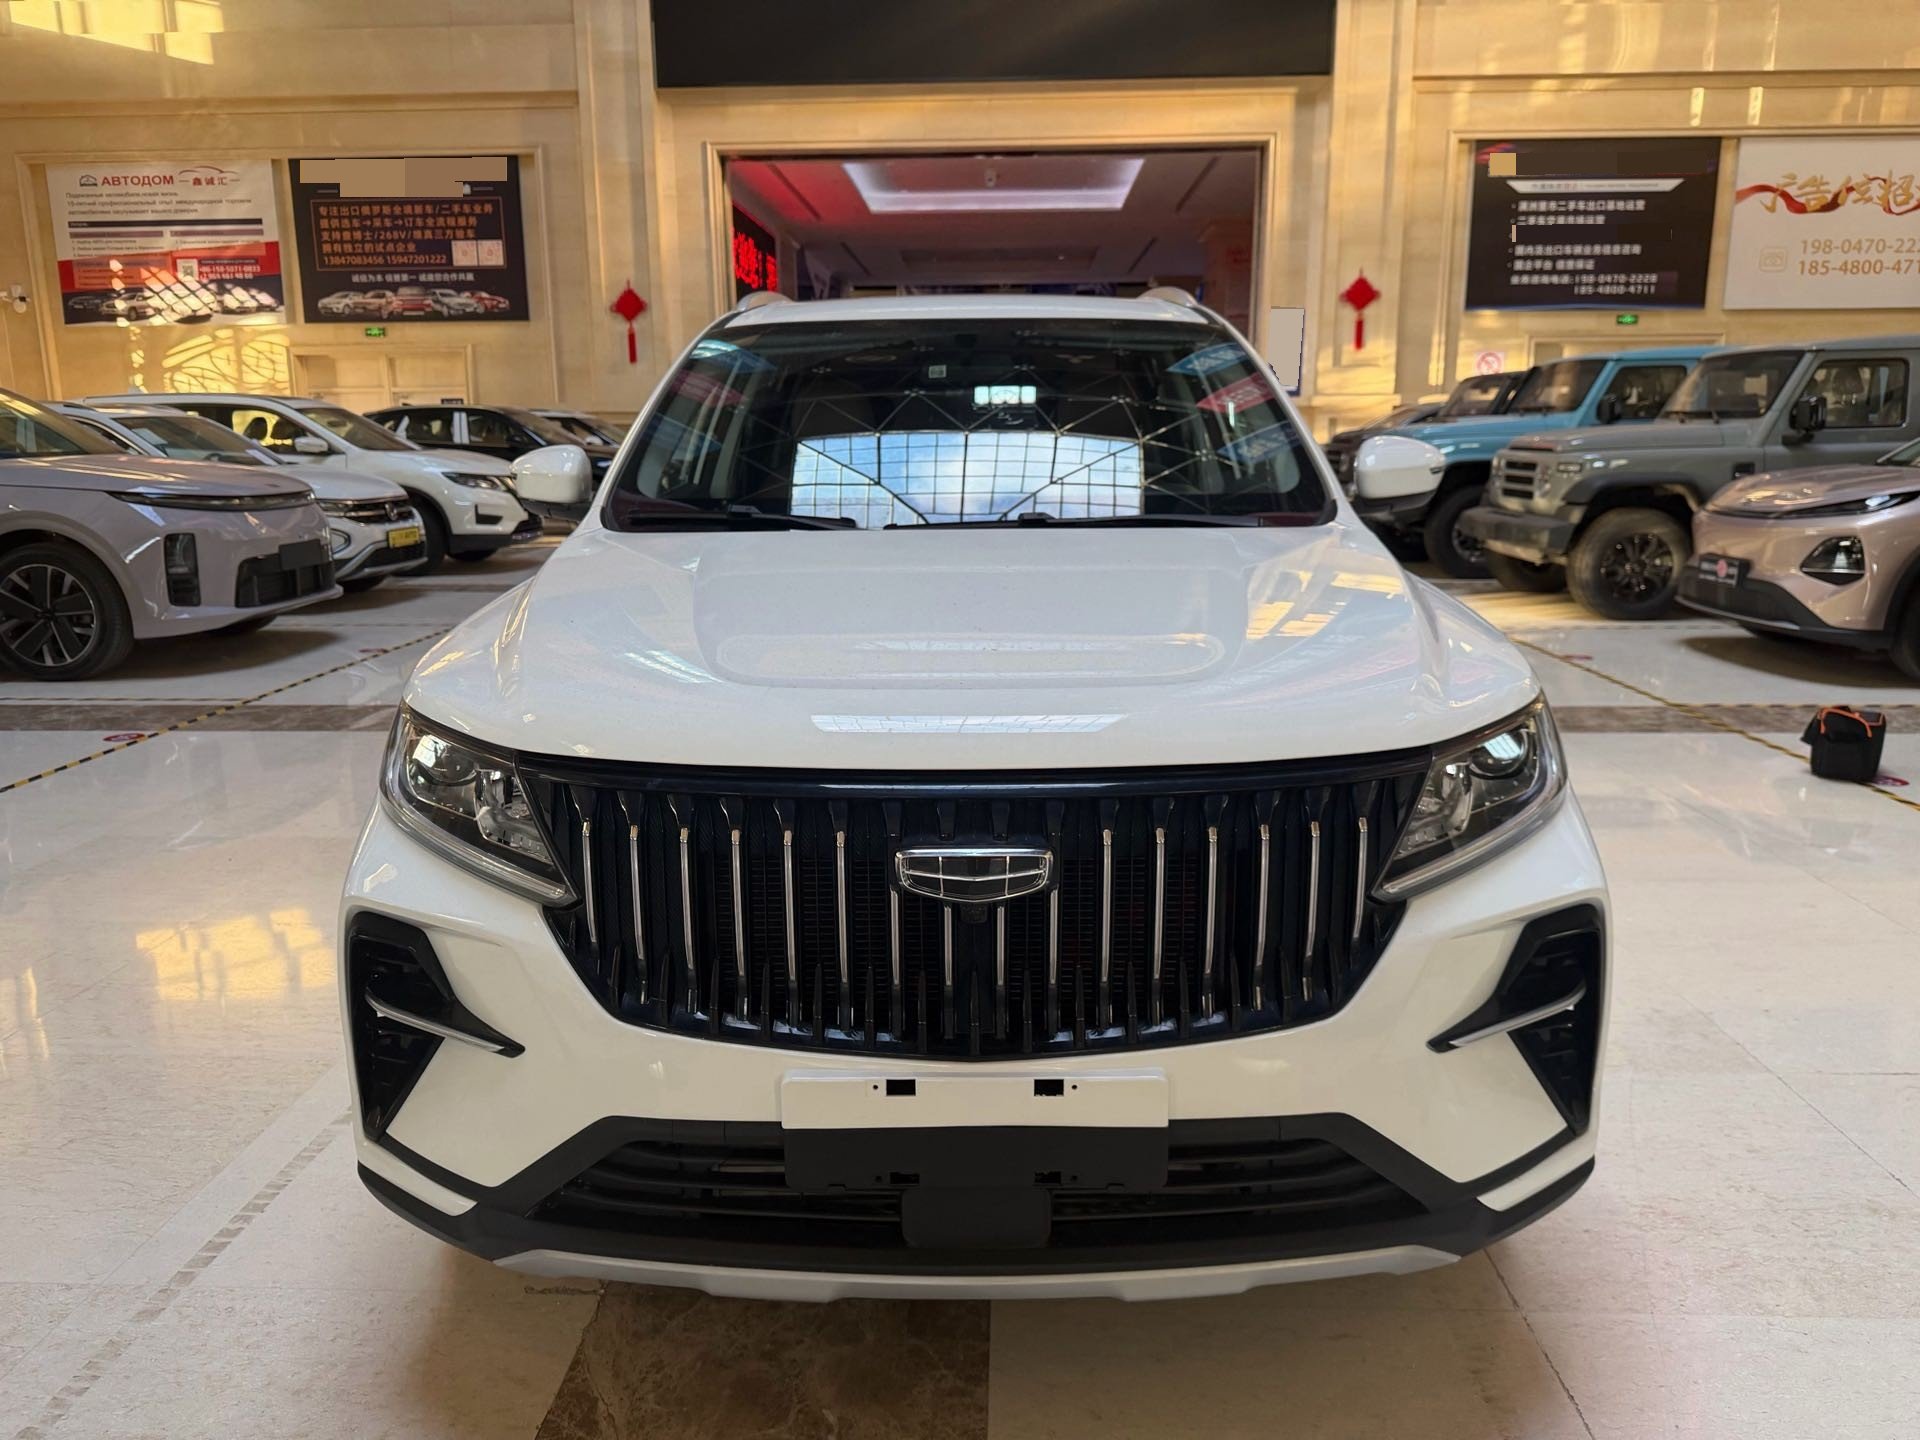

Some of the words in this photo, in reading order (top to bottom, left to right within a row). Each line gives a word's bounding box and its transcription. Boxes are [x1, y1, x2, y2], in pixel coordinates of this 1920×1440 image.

[101, 175, 174, 187] АВТОДОМ
[1760, 169, 1920, 214] 广告位招
